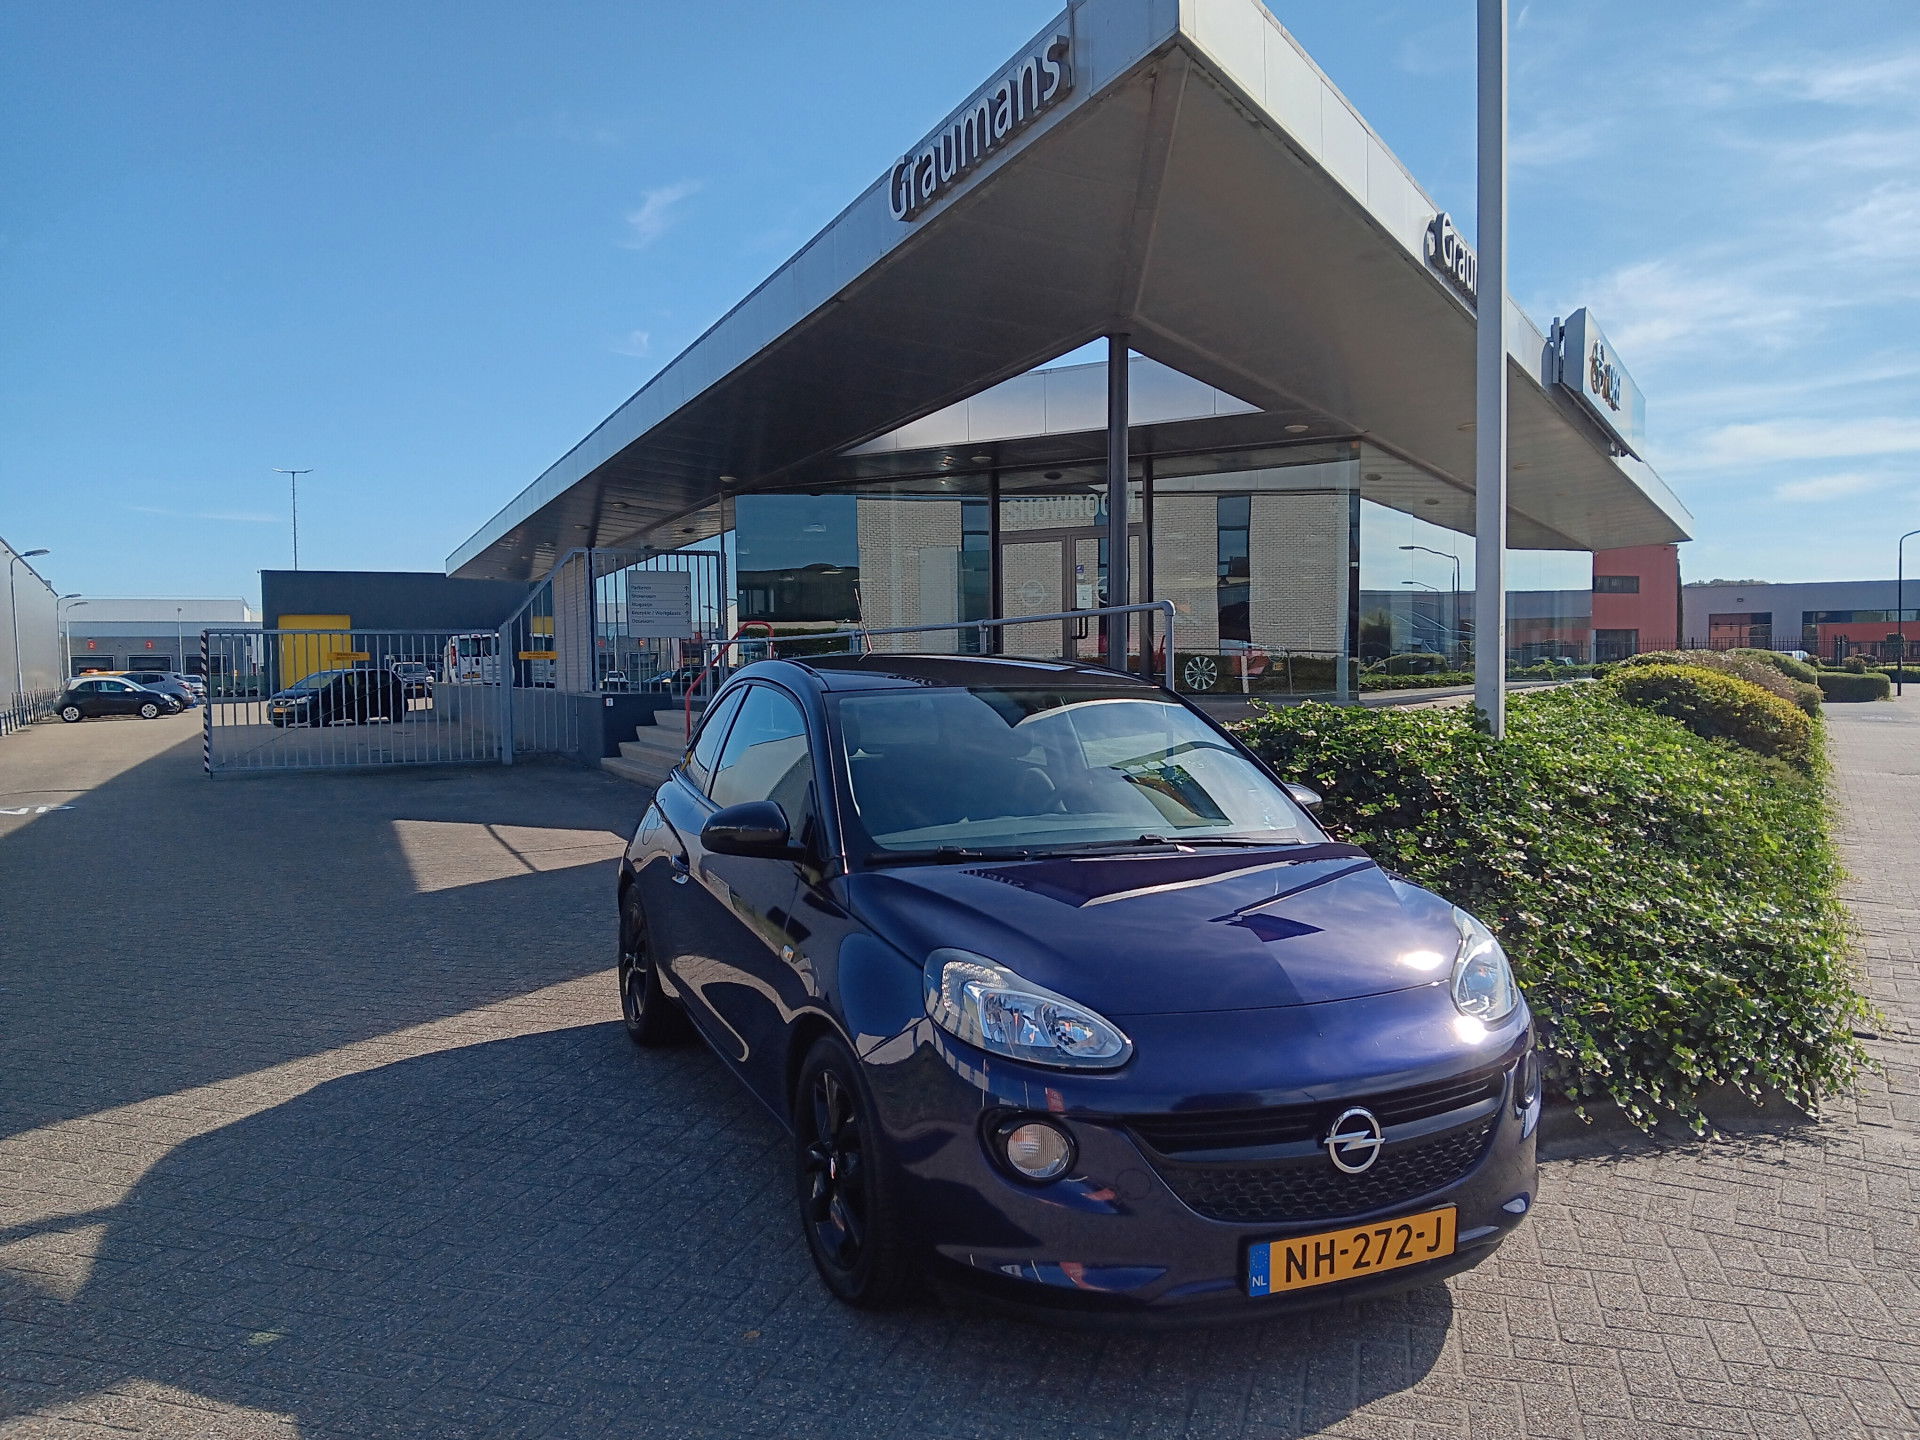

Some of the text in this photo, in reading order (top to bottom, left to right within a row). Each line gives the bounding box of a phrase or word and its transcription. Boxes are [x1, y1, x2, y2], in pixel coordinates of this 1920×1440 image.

[888, 34, 1066, 221] Graumans
[1252, 1275, 1267, 1288] NL
[1285, 1216, 1442, 1283] NH-272-J
